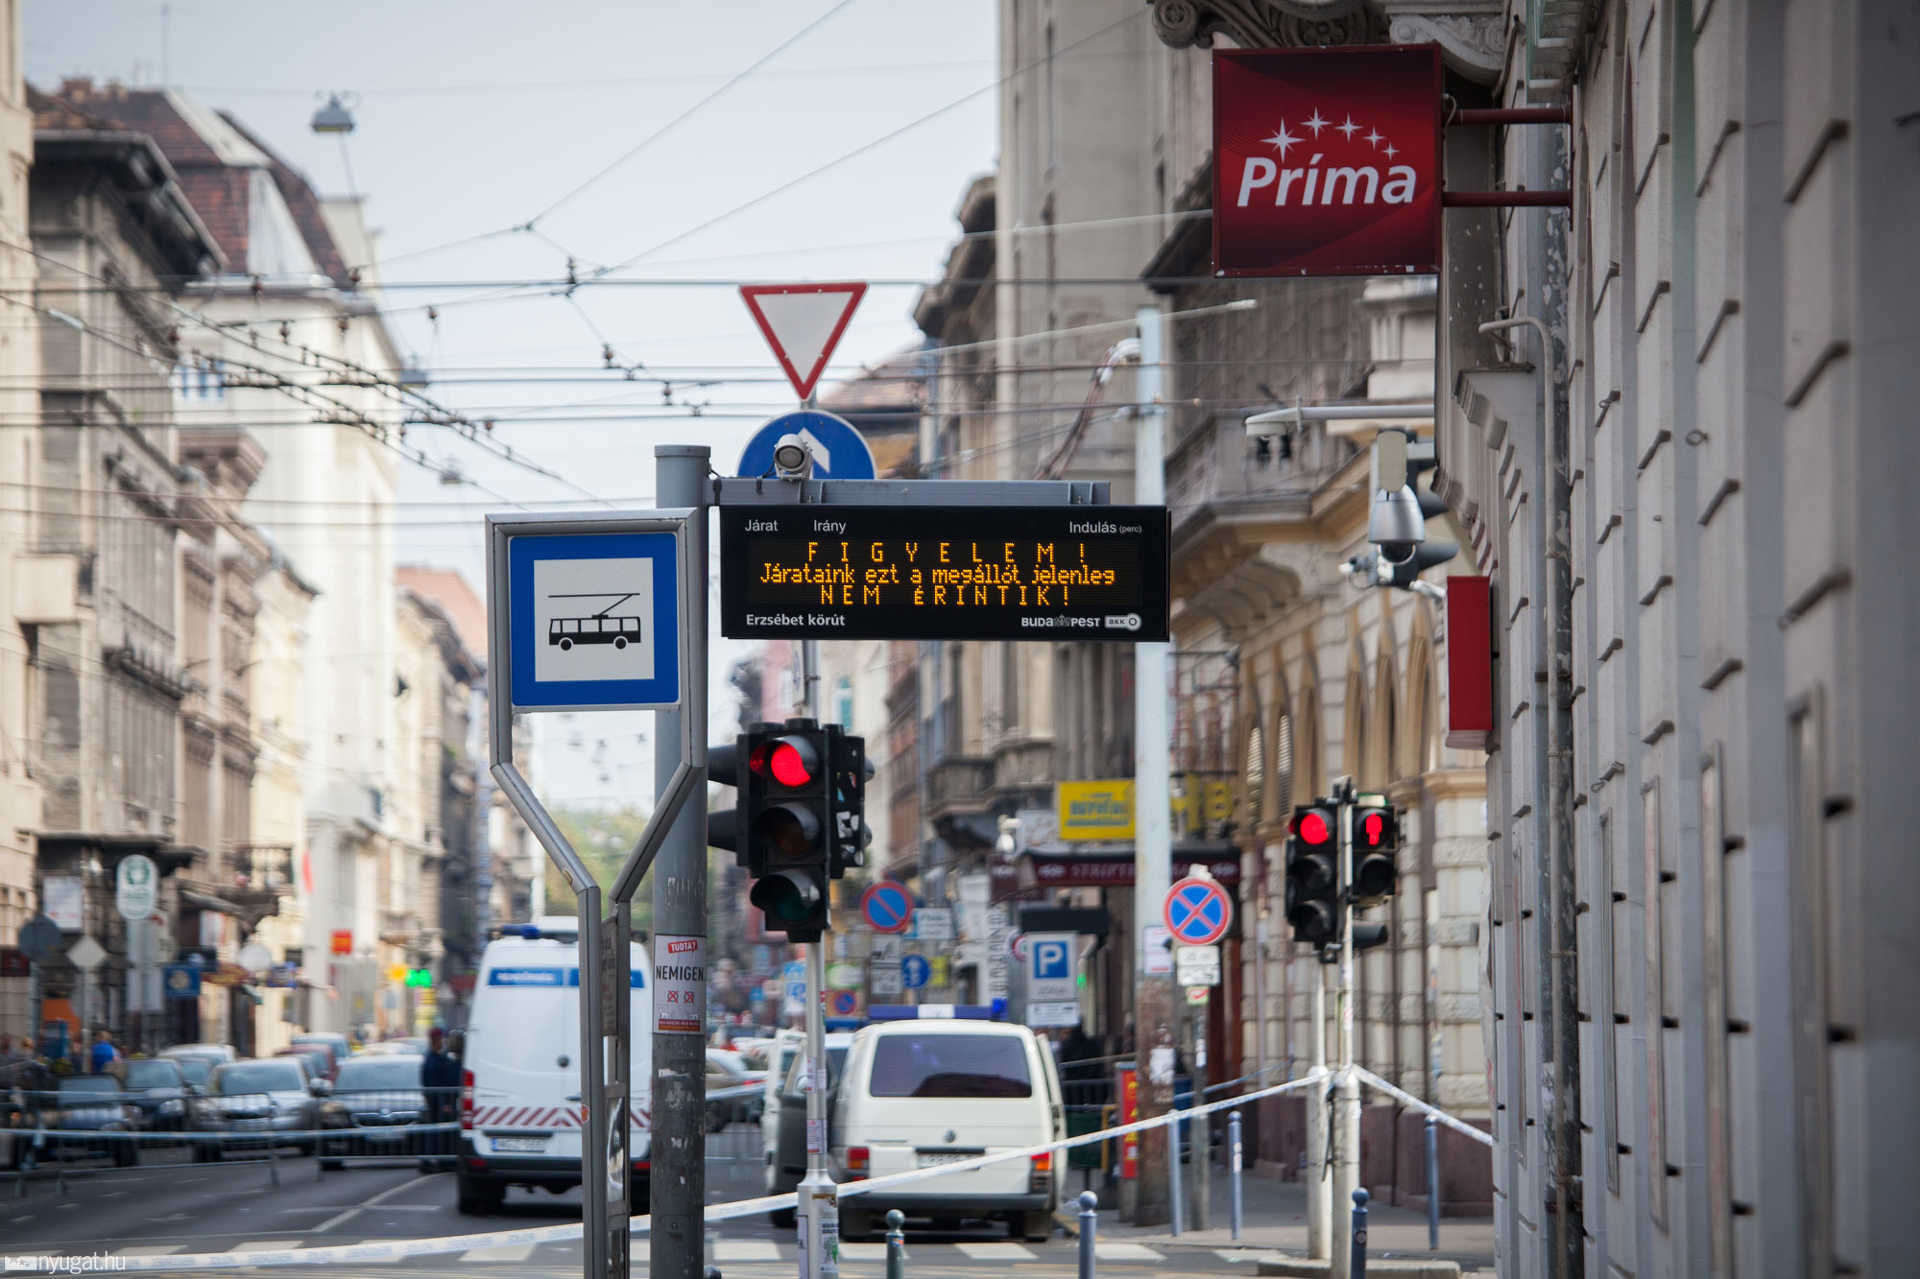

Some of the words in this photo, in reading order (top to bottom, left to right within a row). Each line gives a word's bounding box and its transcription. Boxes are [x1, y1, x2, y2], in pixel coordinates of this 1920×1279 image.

[1237, 153, 1417, 207] Príma
[745, 519, 778, 532] Járat
[813, 519, 846, 535] Irány
[1069, 520, 1117, 534] Indulás
[760, 563, 855, 583] Járataink
[865, 563, 900, 583] ezt
[910, 568, 923, 583] a
[932, 563, 1021, 584] megállót
[1031, 564, 1116, 585] jelenleg
[821, 584, 880, 605] NEM
[746, 613, 804, 626] Erzsébet
[808, 613, 846, 626] körút
[655, 965, 705, 981] NEMIGEN
